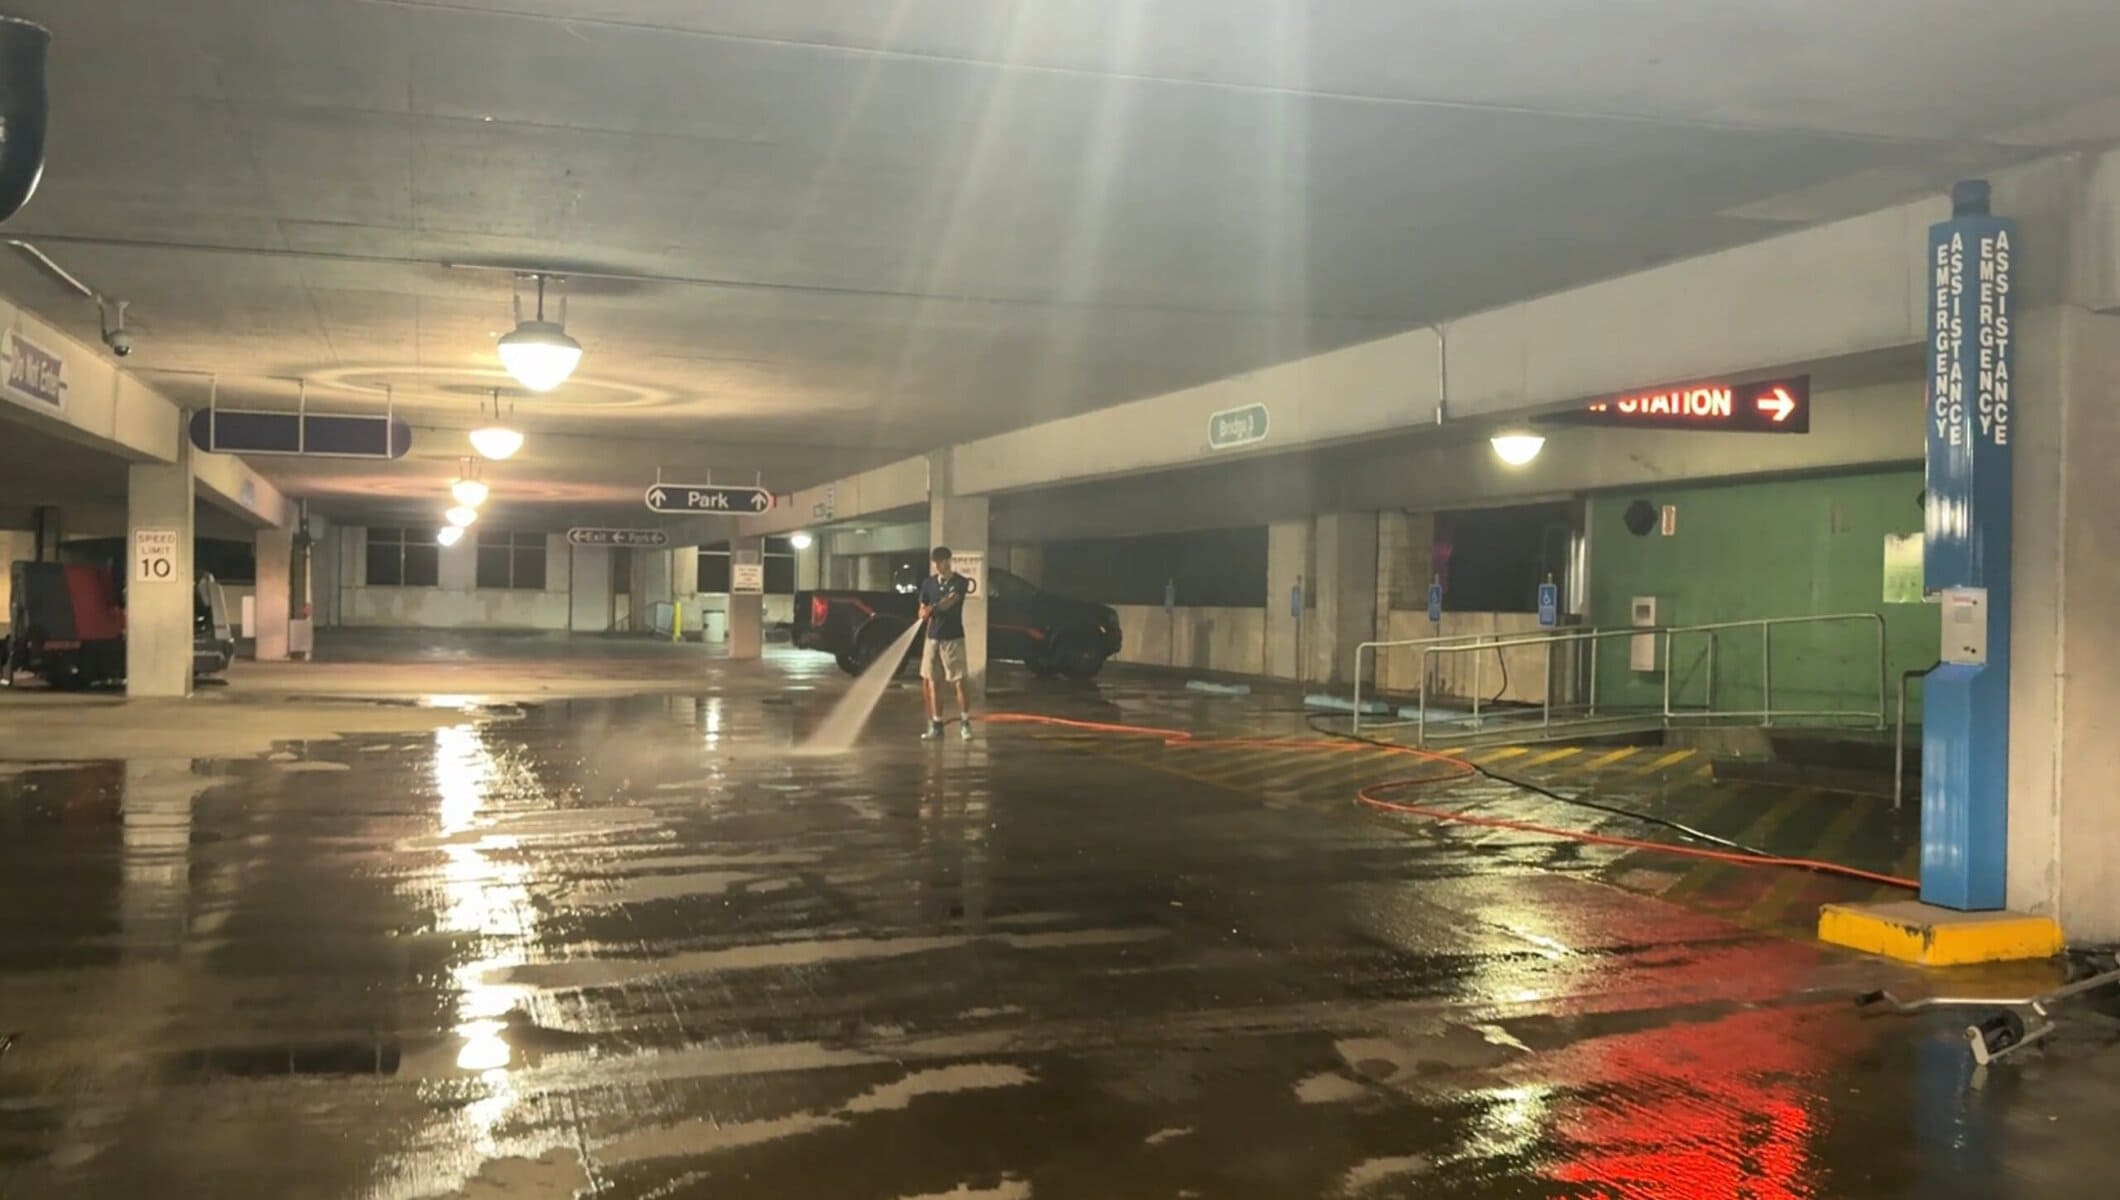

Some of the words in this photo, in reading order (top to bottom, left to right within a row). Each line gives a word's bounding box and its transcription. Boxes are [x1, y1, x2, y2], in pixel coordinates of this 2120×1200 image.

[1936, 244, 1949, 438] EMERGENCY
[1950, 232, 1963, 445] ASSISTANCE
[1979, 238, 1994, 435] EMERGENCY
[1995, 230, 2009, 445] ASSISTANCE
[138, 533, 175, 544] SPEED
[142, 545, 170, 555] LIMIT
[688, 490, 729, 509] Park
[141, 558, 170, 578] 10
